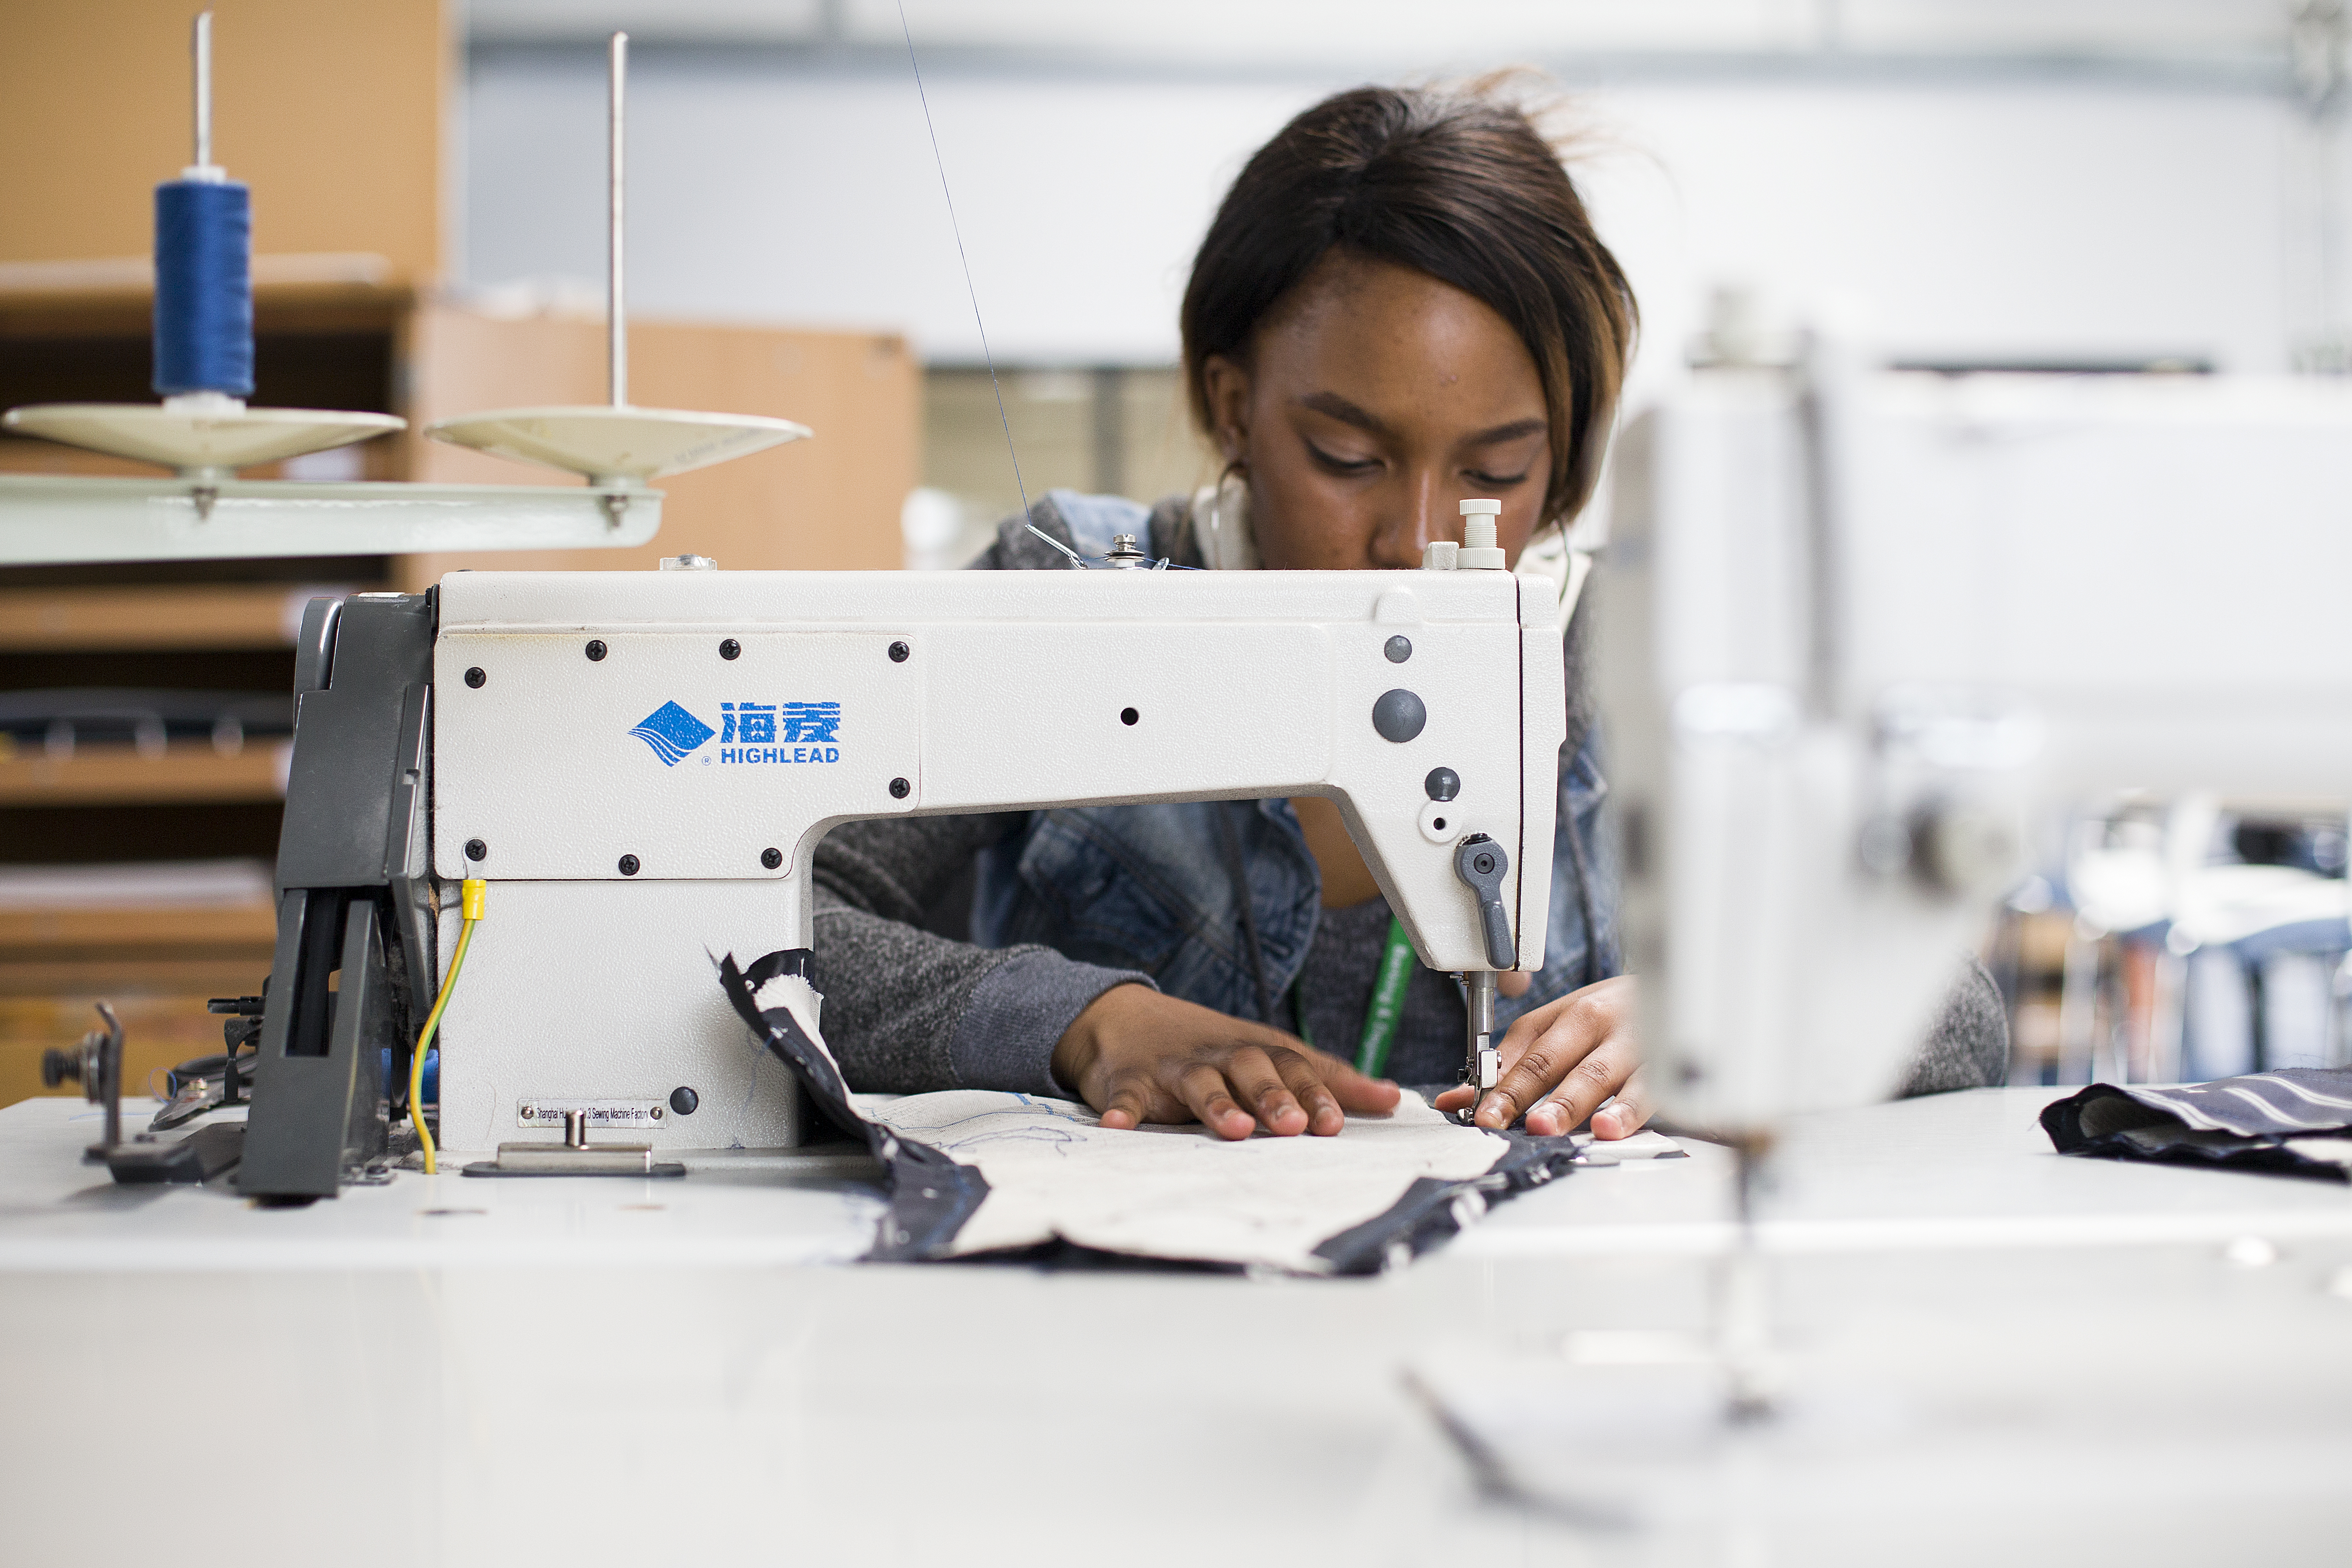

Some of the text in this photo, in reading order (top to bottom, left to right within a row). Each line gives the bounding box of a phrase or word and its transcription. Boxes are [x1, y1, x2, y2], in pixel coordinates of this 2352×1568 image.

[721, 748, 839, 763] HIGHLEAD
[537, 1107, 558, 1122] Shanghai
[592, 1107, 609, 1122] Sewing
[610, 1107, 631, 1119] Machine
[631, 1107, 648, 1122] Factory
